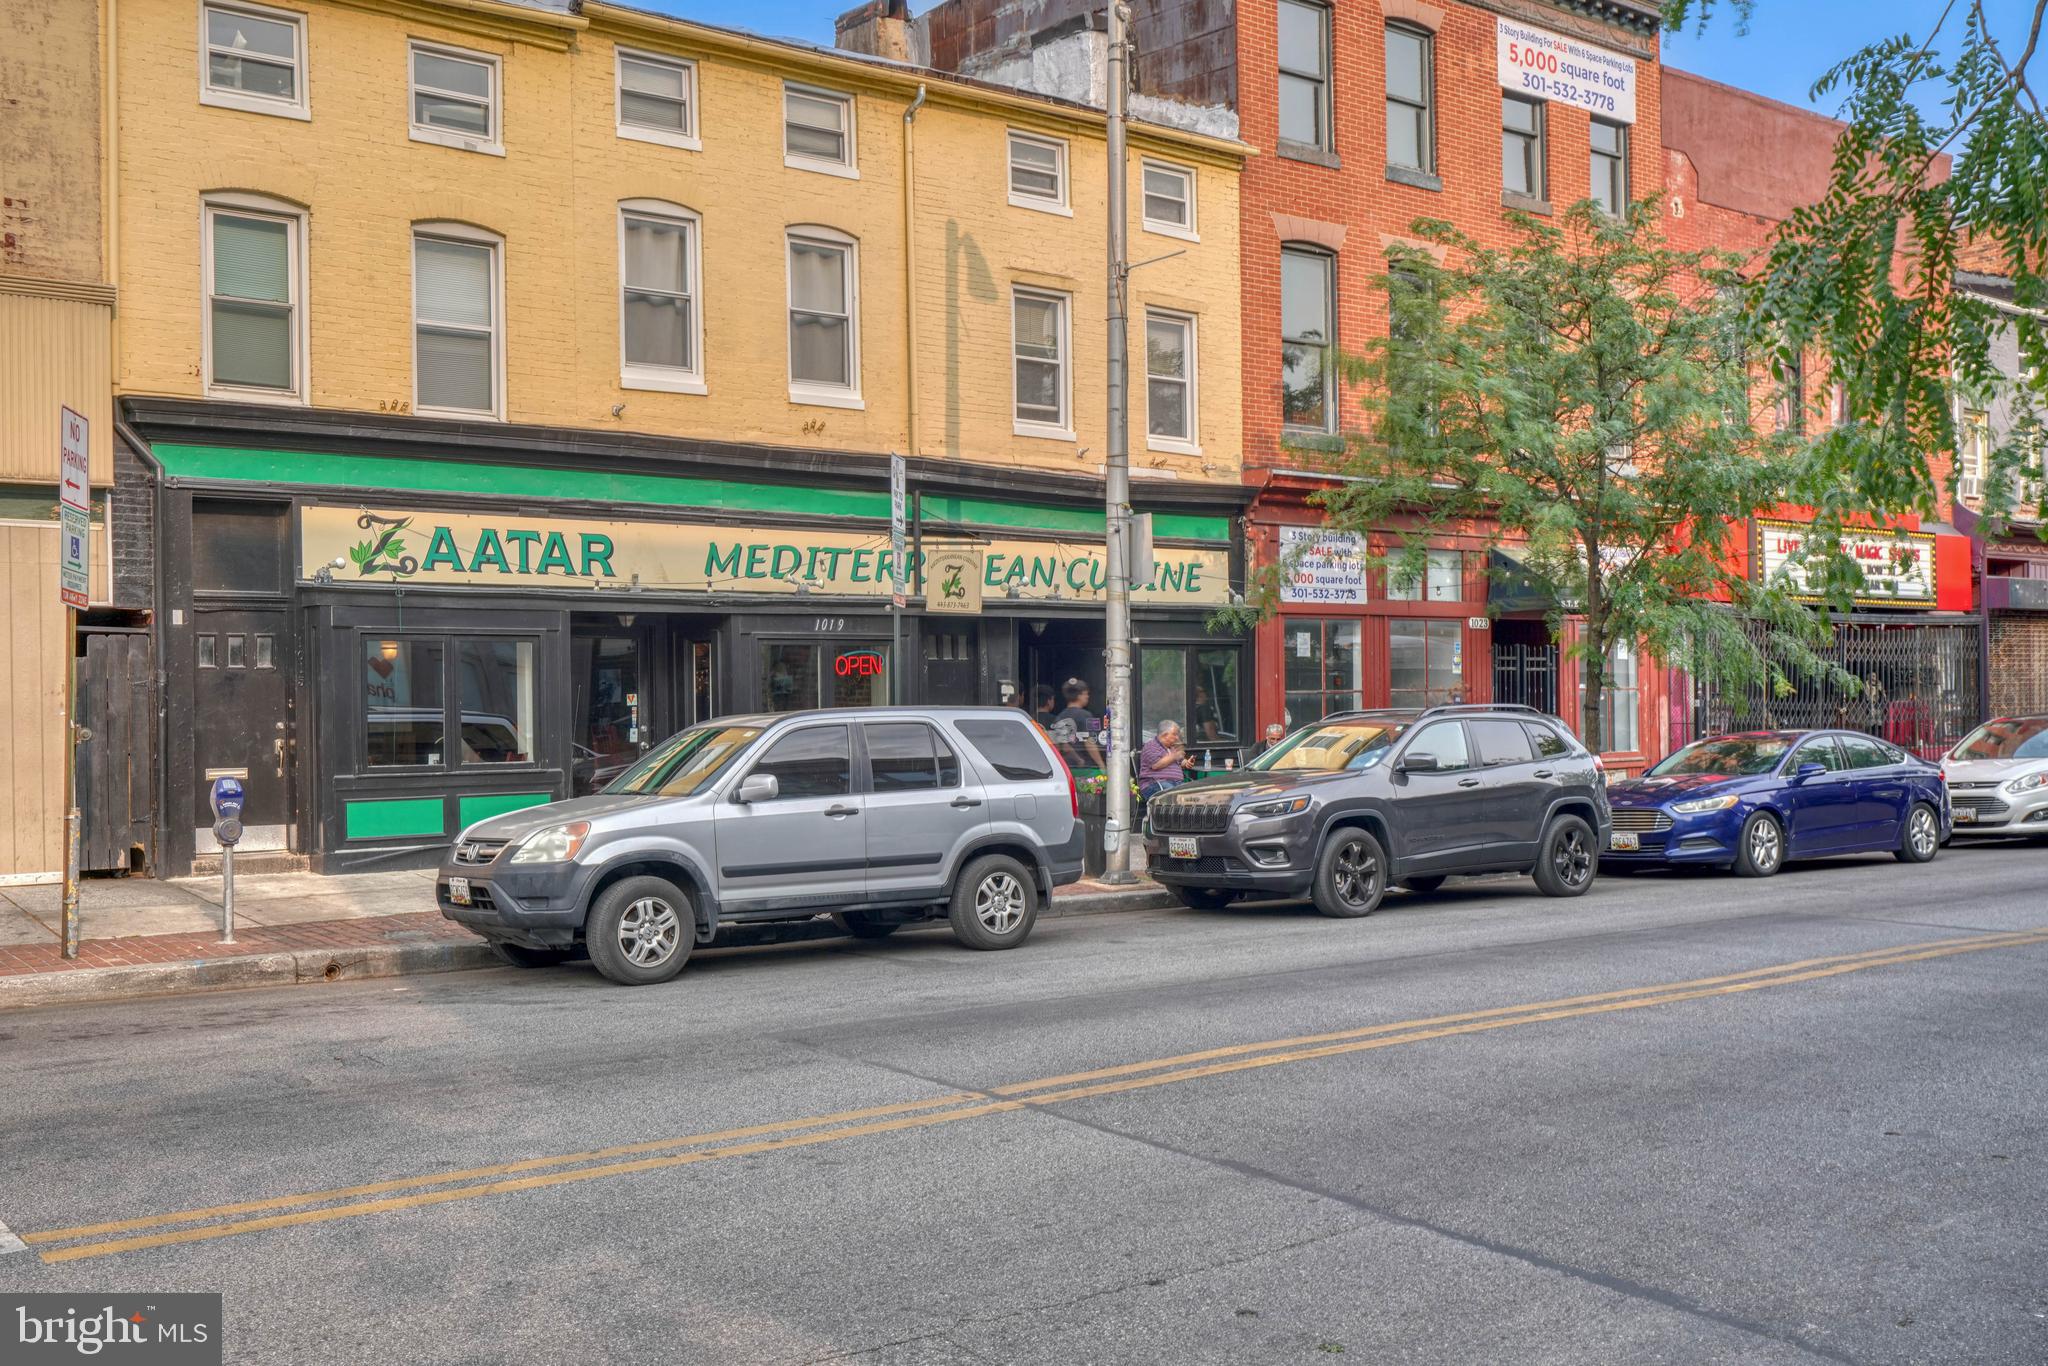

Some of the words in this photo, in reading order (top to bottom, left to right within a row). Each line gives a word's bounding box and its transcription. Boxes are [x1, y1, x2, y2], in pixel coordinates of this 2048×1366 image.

[1499, 23, 1503, 33] 3
[1504, 25, 1520, 40] Story
[1520, 29, 1543, 48] Building
[1543, 38, 1553, 48] For
[1553, 41, 1568, 54] SALE
[1568, 44, 1581, 57] With
[1586, 51, 1602, 66] Space
[1603, 55, 1622, 73] Parking
[1622, 63, 1633, 74] Lots
[1509, 43, 1558, 74] 5,000
[1560, 61, 1600, 83] square
[1603, 71, 1625, 92] foot
[1522, 72, 1615, 112] 301-532-3778
[70, 421, 80, 443] NO
[63, 447, 87, 474] PARKING
[64, 509, 87, 528] RESERVED
[65, 522, 85, 539] PARKING
[1291, 531, 1297, 540] 3
[1298, 532, 1321, 544] Story
[1322, 533, 1356, 546] building
[350, 513, 617, 578] ZAATAR
[1309, 545, 1332, 556] SALE
[1334, 547, 1353, 557] with
[1855, 544, 1883, 560] MAGIC
[1316, 559, 1348, 573] parking
[1315, 575, 1343, 585] square
[1344, 575, 1362, 585] foot
[815, 618, 845, 632] 1019
[1470, 618, 1489, 629] 1023
[834, 655, 883, 676] OPEN
